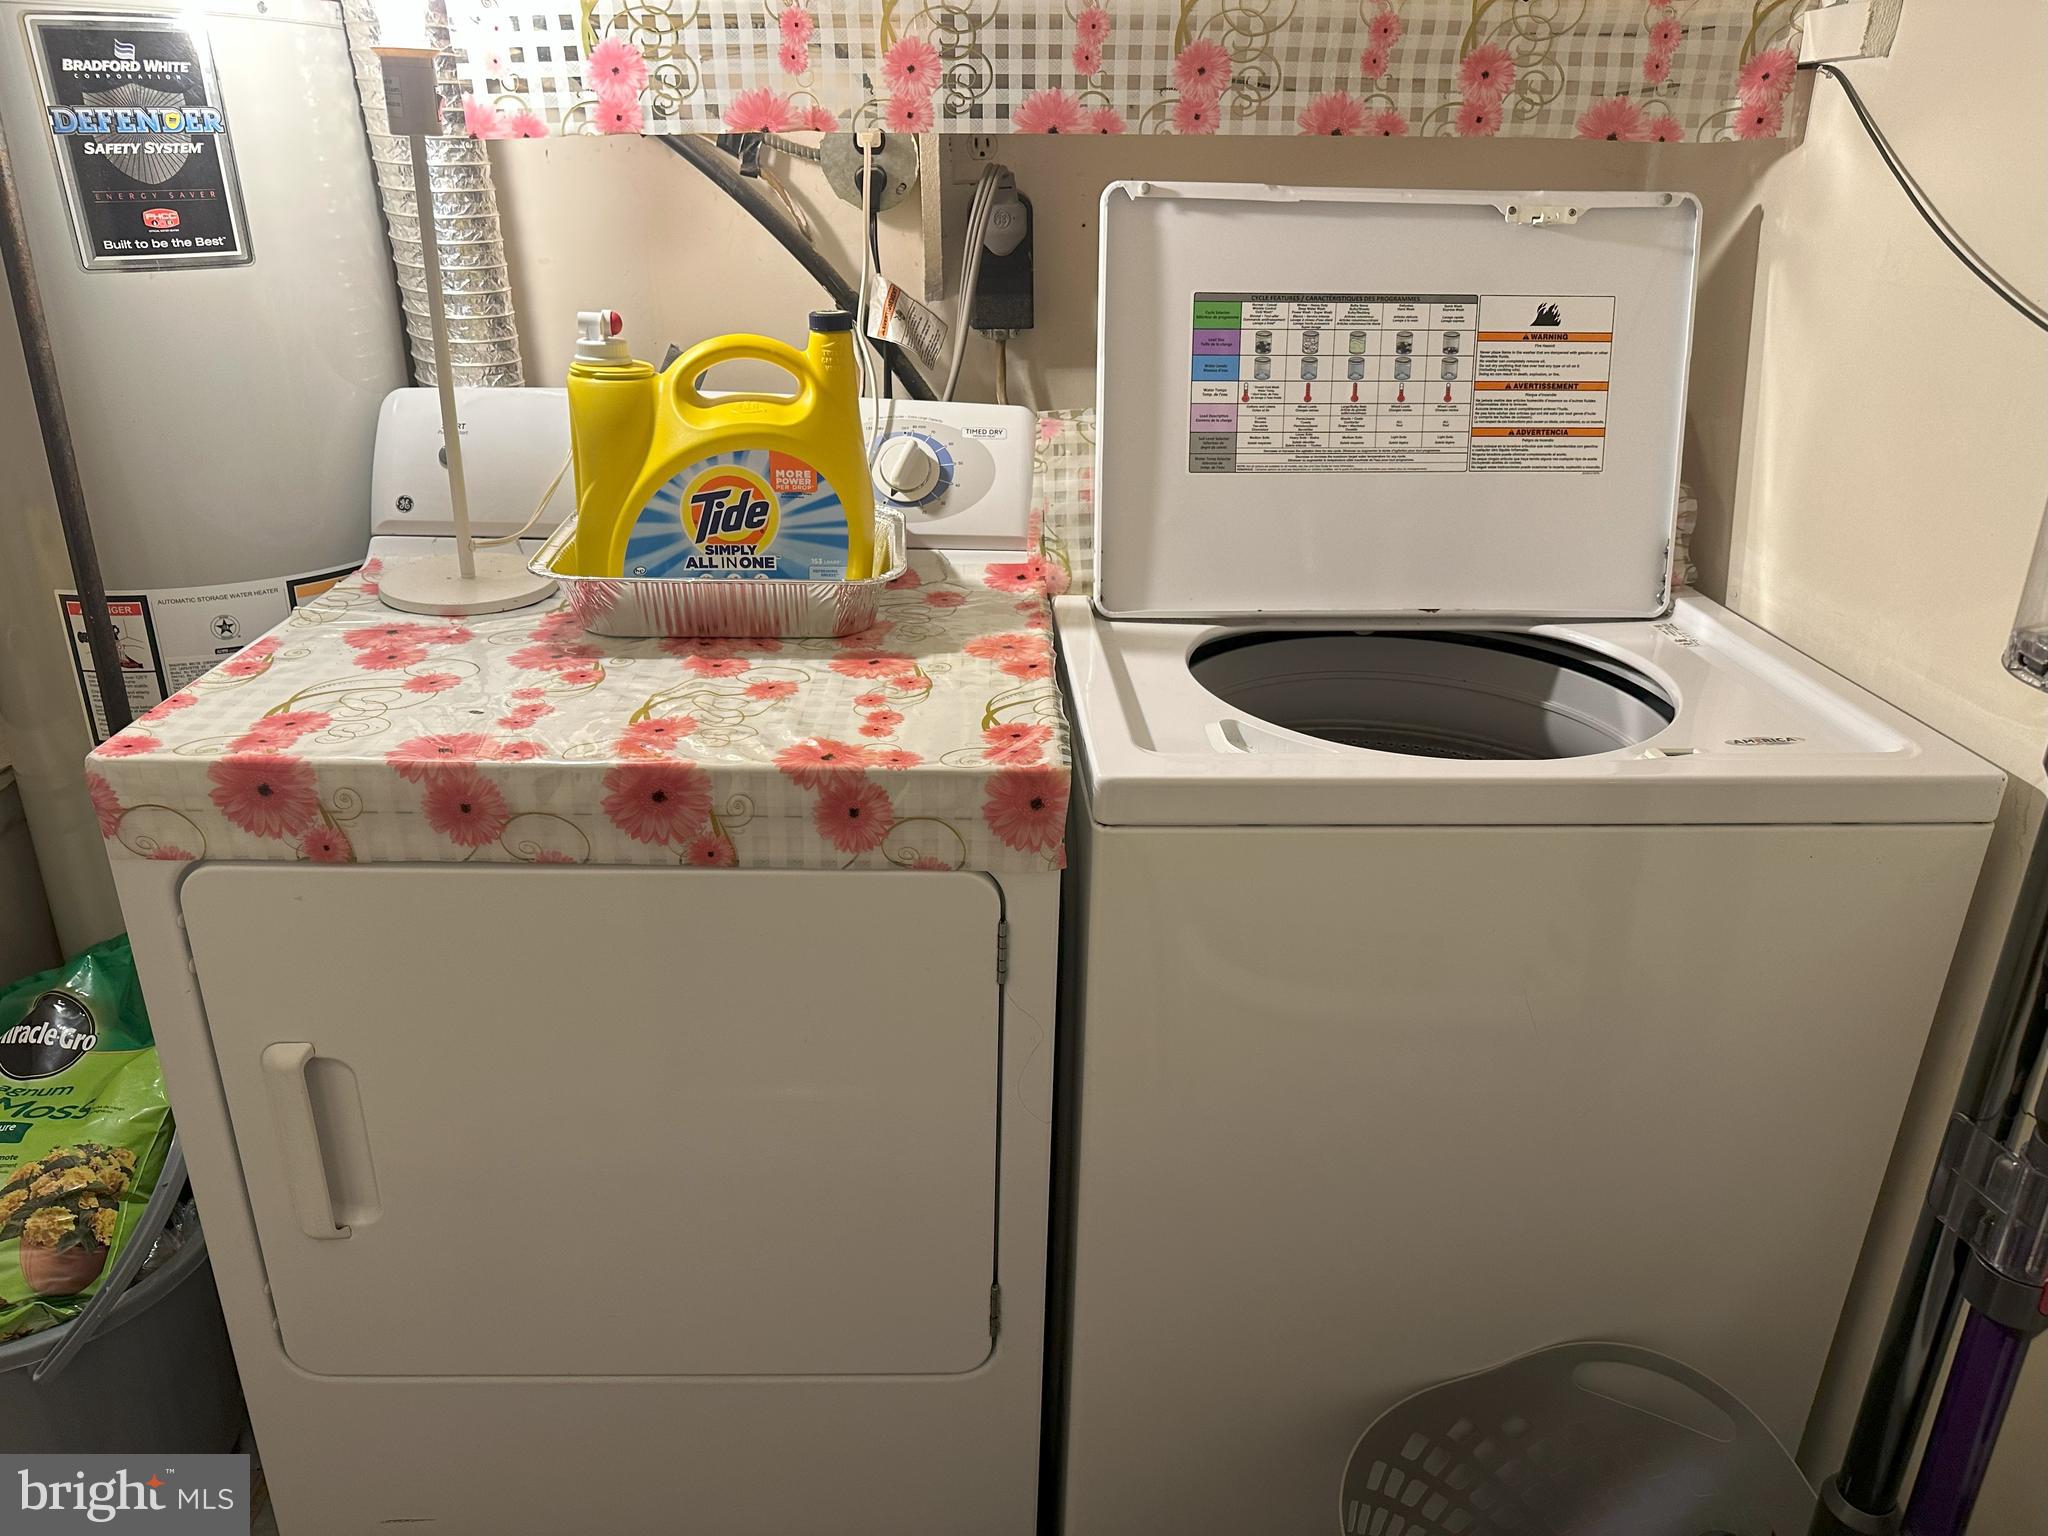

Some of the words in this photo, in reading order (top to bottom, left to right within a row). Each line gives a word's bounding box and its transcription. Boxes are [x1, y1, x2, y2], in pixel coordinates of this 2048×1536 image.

[62, 58, 141, 72] BRADFORD
[143, 60, 190, 73] WHITE
[48, 105, 226, 135] DEFENDER
[84, 142, 141, 155] SAFETY
[144, 143, 204, 155] SYSTEM
[95, 192, 158, 201] ENERGY
[168, 190, 217, 199] SAVER
[103, 240, 133, 250] Built
[134, 239, 149, 249] to
[151, 238, 169, 248] be
[170, 237, 193, 247] the
[776, 470, 812, 478] MORE
[690, 488, 770, 544] Tide
[705, 545, 758, 556] SIMPLY
[686, 557, 718, 568] ALL
[722, 557, 738, 568] IN
[740, 557, 775, 568] ONE
[157, 596, 196, 605] AUTOMATIC
[197, 594, 229, 602] STORAGE
[230, 591, 253, 600] WATER
[254, 587, 279, 597] HEATER
[0, 1022, 97, 1052] iracle-Gro
